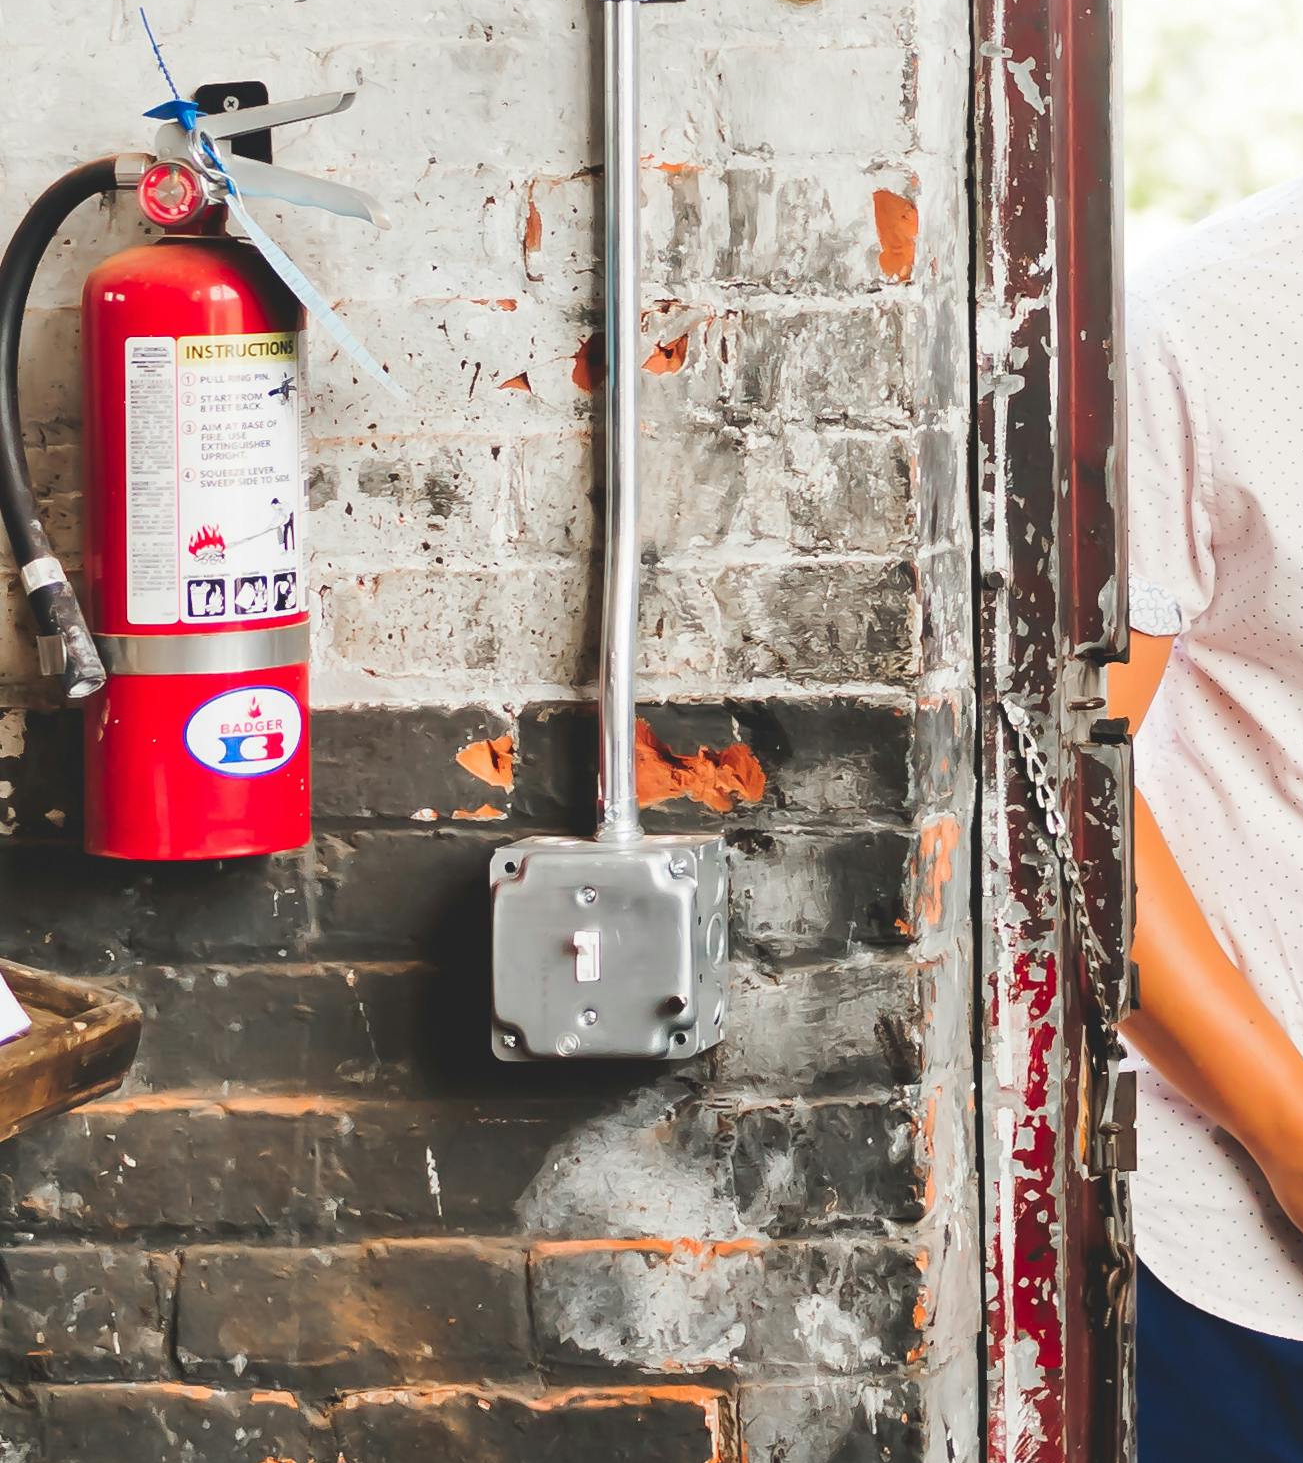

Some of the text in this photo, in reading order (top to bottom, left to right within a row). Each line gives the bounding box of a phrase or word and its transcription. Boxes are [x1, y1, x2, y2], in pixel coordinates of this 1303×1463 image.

[186, 340, 294, 359] INSTRUCTIONS
[200, 375, 224, 384] PULL
[200, 394, 232, 403] START
[209, 404, 232, 412] FEET
[201, 424, 222, 432] AIM
[241, 422, 265, 430] BASE
[228, 432, 247, 440] USE
[201, 440, 271, 451] EXTINGUISHER
[200, 479, 235, 488] SWEEP
[261, 476, 272, 484] TO
[220, 719, 283, 734] BADGER
